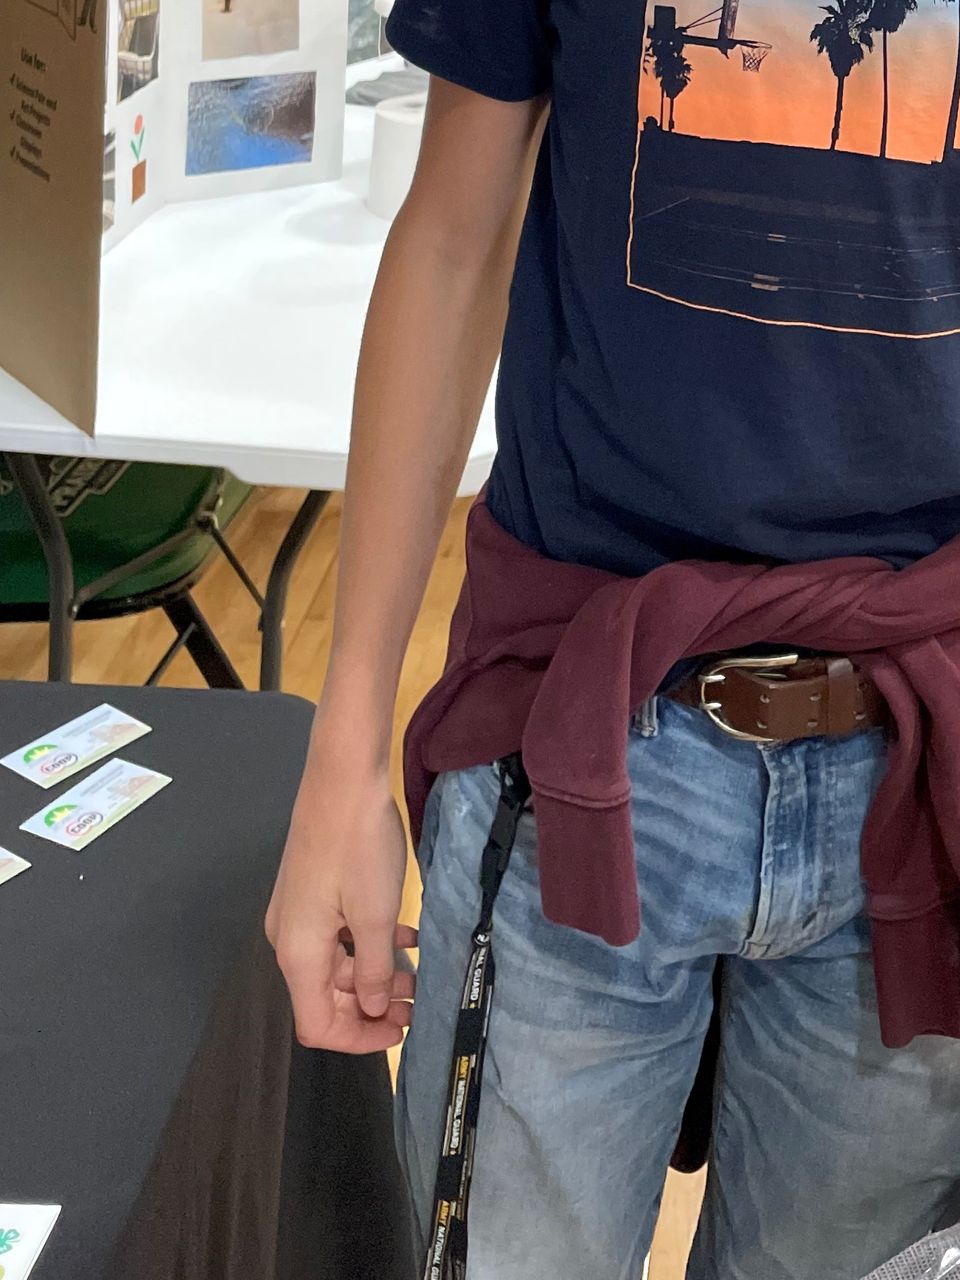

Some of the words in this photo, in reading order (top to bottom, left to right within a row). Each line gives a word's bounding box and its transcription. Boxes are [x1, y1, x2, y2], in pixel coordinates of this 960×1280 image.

[470, 968, 482, 1001] GUARD
[450, 1119, 461, 1149] GUARD
[432, 1224, 446, 1265] NATIONAL
